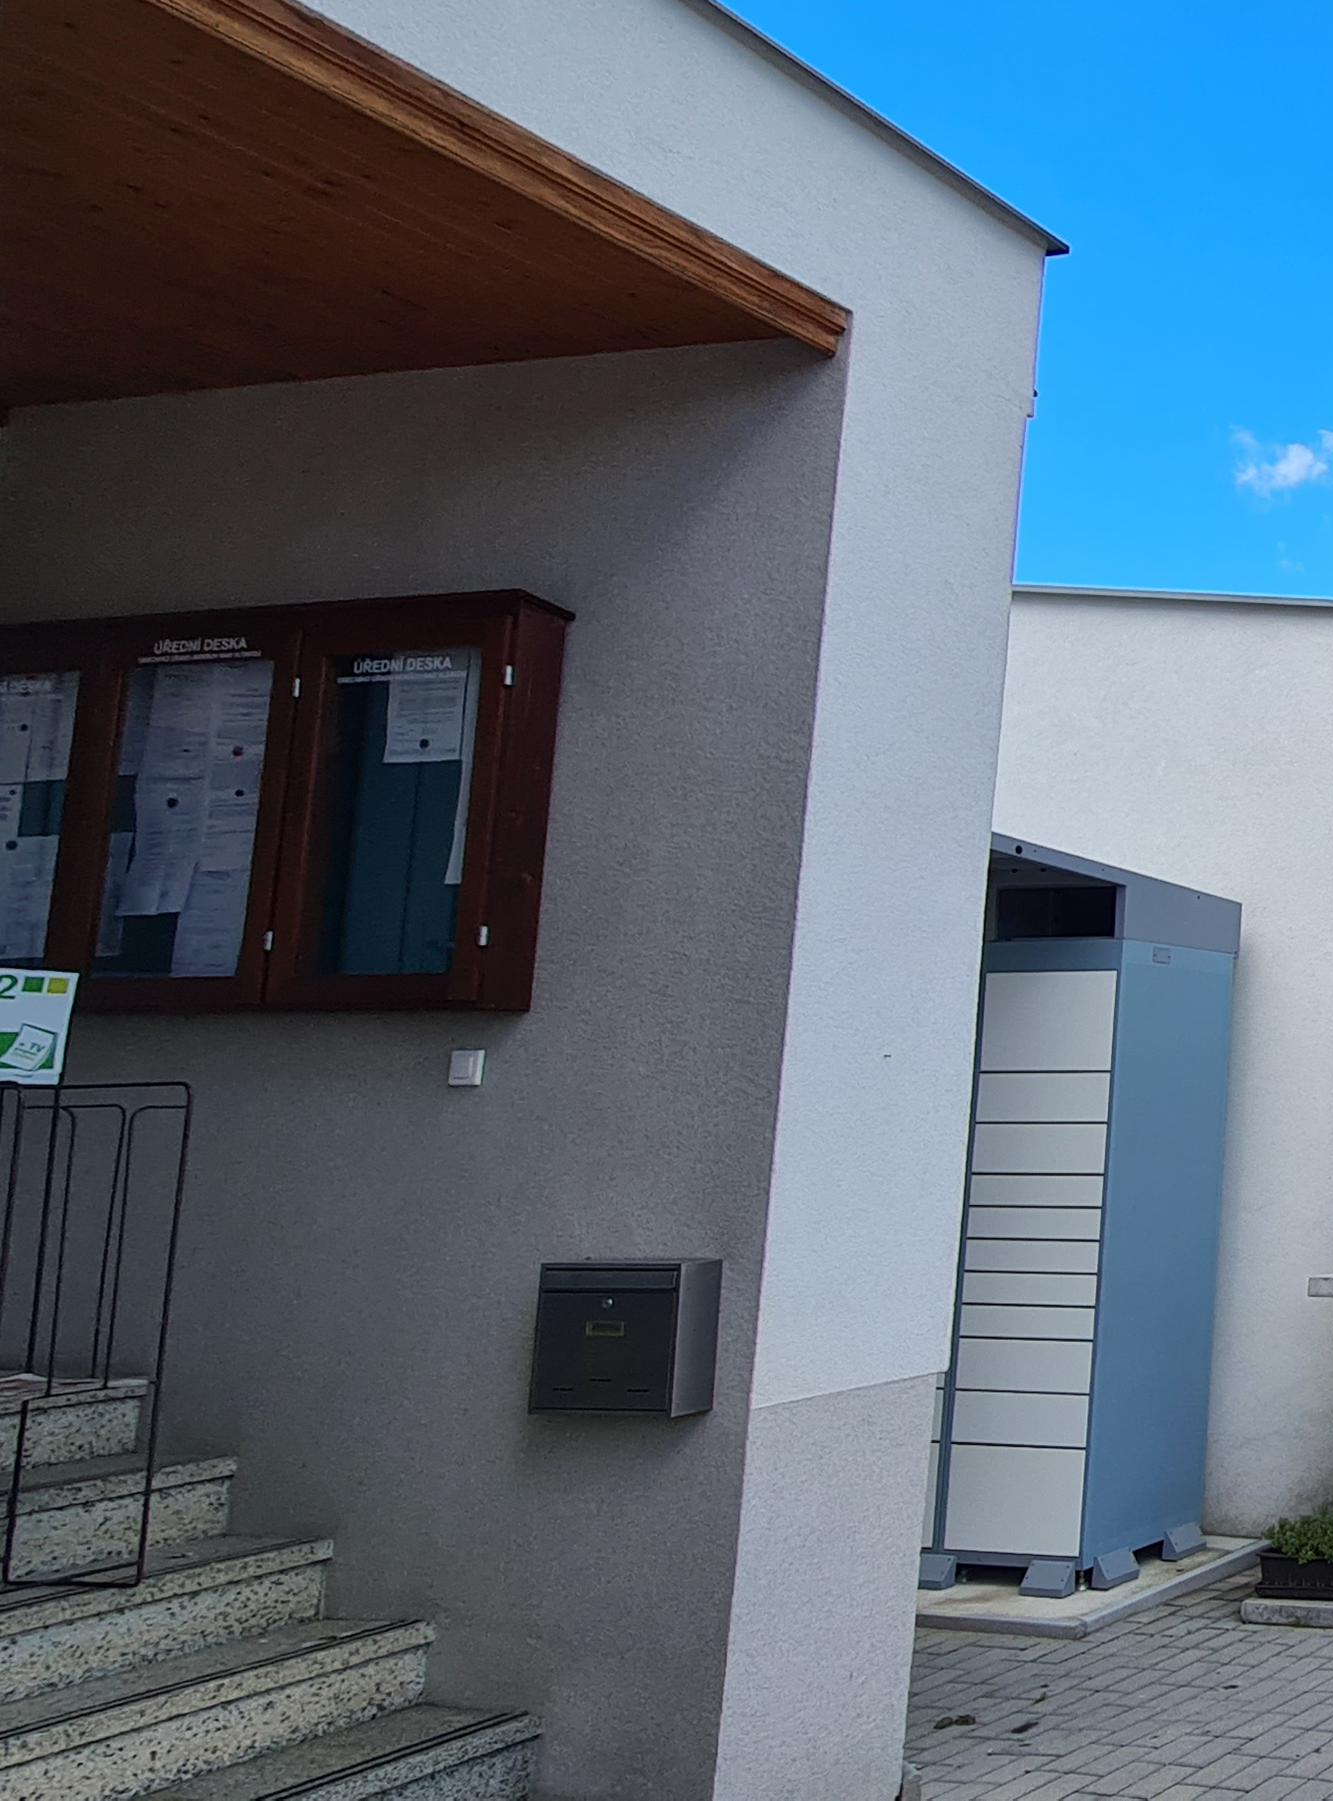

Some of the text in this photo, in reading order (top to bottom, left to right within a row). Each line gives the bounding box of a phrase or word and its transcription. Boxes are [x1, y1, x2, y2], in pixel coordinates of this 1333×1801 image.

[203, 636, 248, 652] DESKA
[353, 655, 452, 674] ÚŘEDNÍ DESKA
